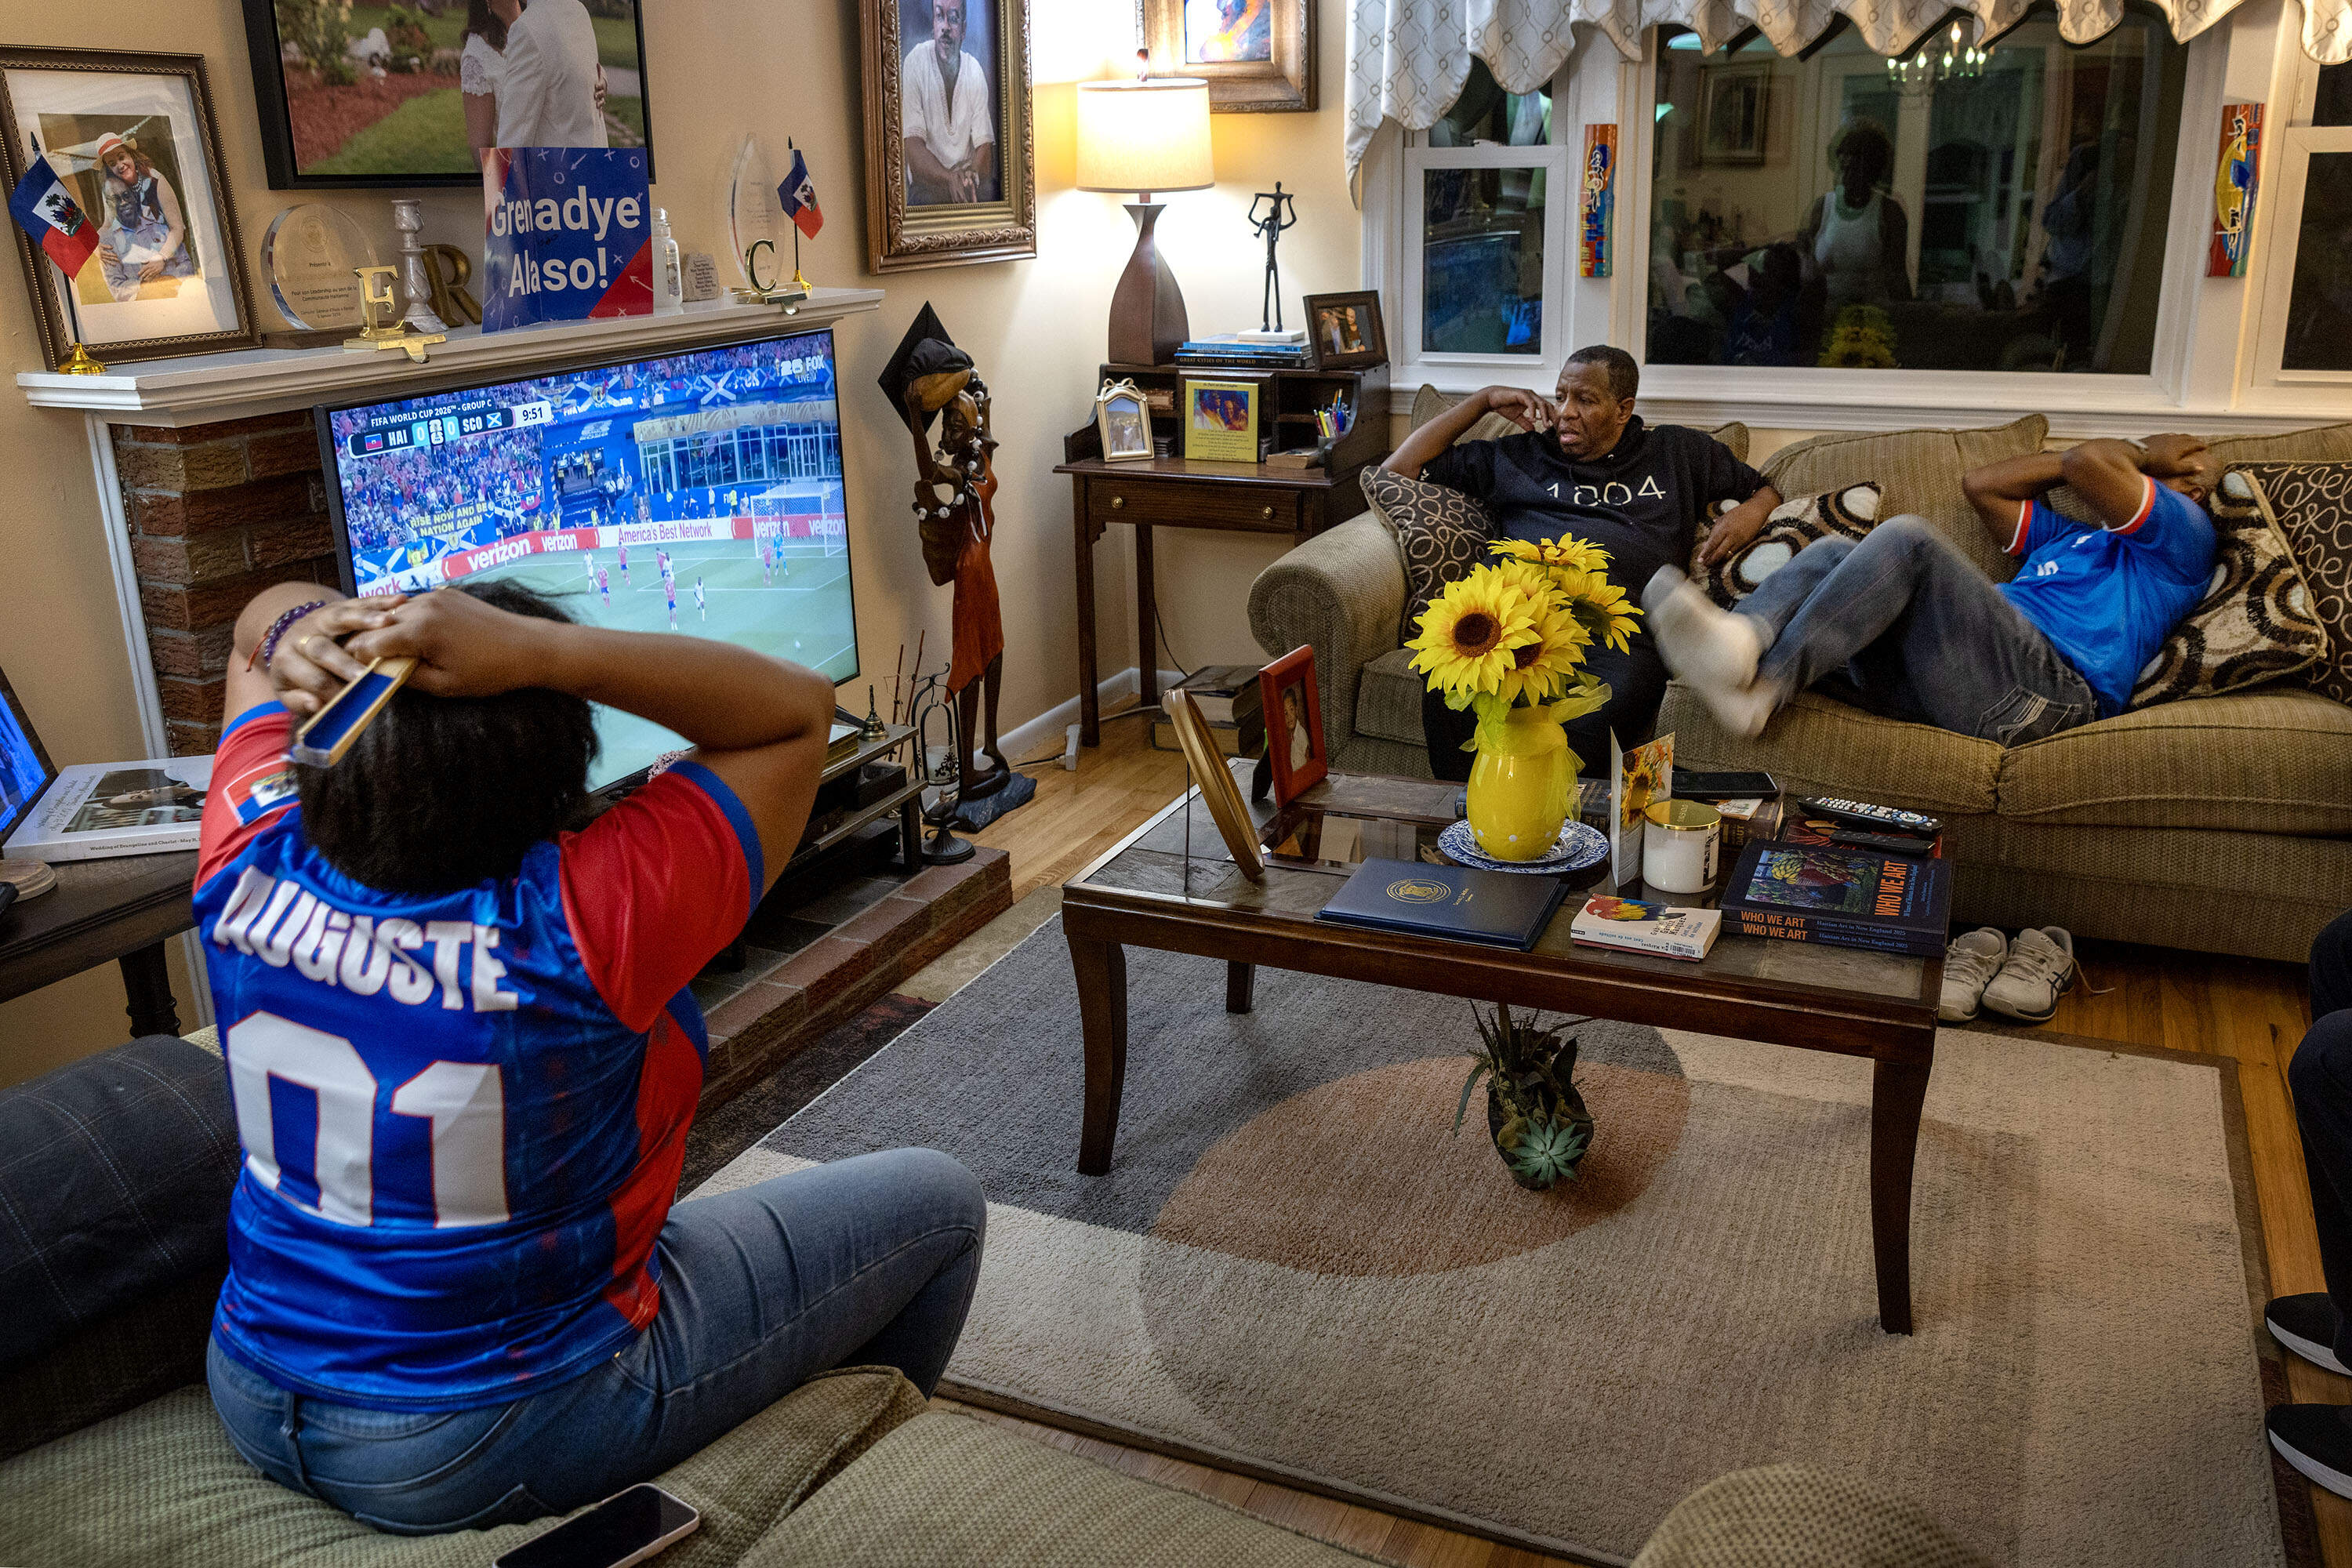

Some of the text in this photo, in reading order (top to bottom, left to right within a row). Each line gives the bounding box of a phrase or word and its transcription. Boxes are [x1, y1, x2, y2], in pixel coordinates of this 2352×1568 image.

[491, 186, 641, 241] Grenadye
[508, 247, 608, 298] Alaso!
[745, 238, 776, 294] C
[354, 265, 405, 338] E
[805, 354, 825, 372] FOX
[371, 417, 389, 427] FIFA
[389, 412, 418, 423] WORLD
[419, 409, 434, 419] CUP
[461, 401, 485, 412] GROUP
[485, 399, 492, 408] C
[522, 407, 543, 421] 9:51
[388, 426, 425, 446] HAI 0
[447, 416, 483, 435] 0 SCO
[434, 510, 454, 524] NOW
[456, 506, 475, 517] AND
[477, 502, 488, 513] BE
[419, 514, 483, 536] NATION AGAIN
[618, 521, 713, 544] America's Best Network
[541, 530, 578, 552] verizon
[467, 538, 532, 572] verizon
[1875, 860, 1907, 916] WHO WE ART
[1740, 910, 1806, 928] WHO WE ART
[1816, 920, 1838, 928] Haitian
[1869, 925, 1892, 935] England
[213, 865, 518, 1013] AUGUSTE
[1743, 923, 1767, 935] WHO
[1769, 926, 1785, 938] WE
[1786, 929, 1808, 941] ART
[1818, 932, 1840, 941] Haitian
[1871, 938, 1893, 949] England
[227, 1009, 511, 1229] 01
